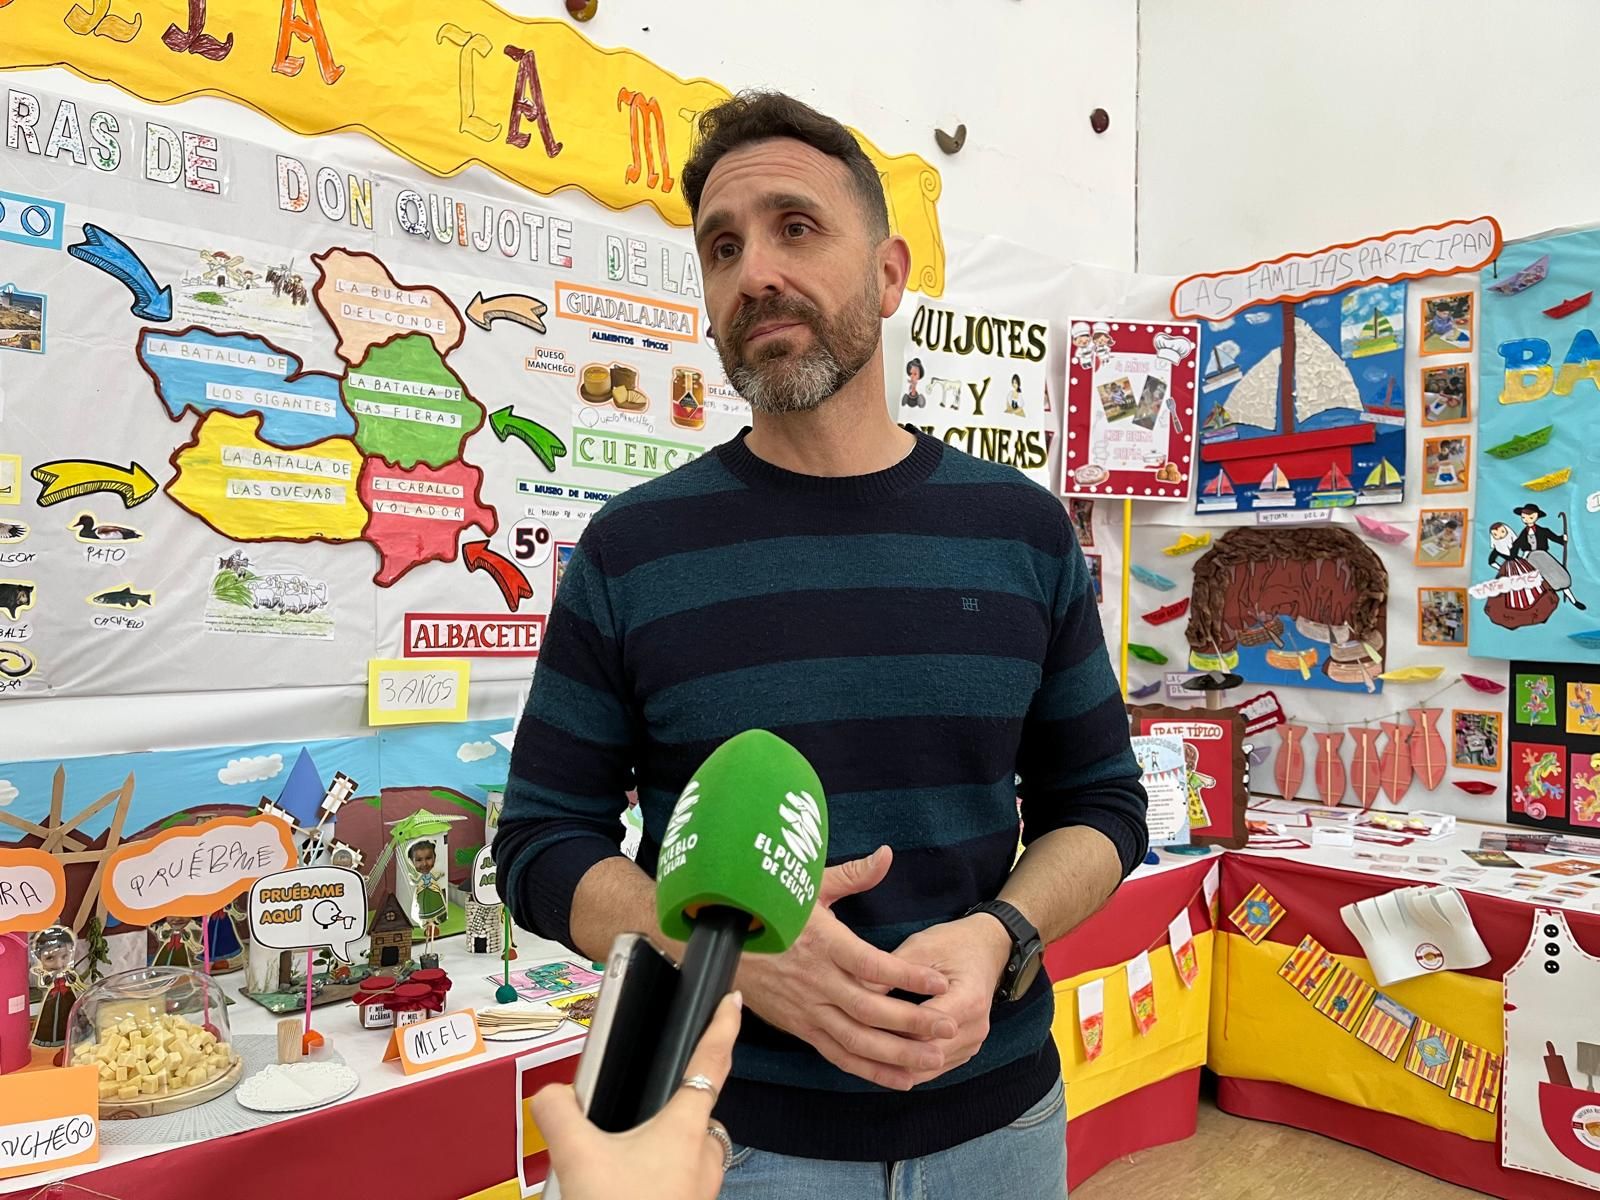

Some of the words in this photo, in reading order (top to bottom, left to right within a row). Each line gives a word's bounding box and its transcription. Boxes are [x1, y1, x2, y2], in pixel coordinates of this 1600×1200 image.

[436, 23, 563, 158] LA
[6, 88, 122, 172] RAS
[146, 121, 222, 195] DE
[276, 154, 374, 230] DON
[396, 189, 573, 268] QUIJOTE
[606, 235, 649, 287] DE
[660, 247, 701, 298] LA
[1178, 278, 1234, 316] LAS
[1246, 253, 1352, 298] FAMILIAS
[1358, 229, 1492, 274] PARTICIPAN
[338, 281, 360, 294] LA
[371, 286, 429, 306] BURLA
[343, 304, 376, 321] DEL
[385, 312, 444, 331] CONDE
[566, 291, 692, 334] GUADALAJARA
[592, 330, 635, 346] ALIMENTOS
[911, 304, 1047, 362] QUIJOTES
[148, 341, 169, 356] LA
[181, 343, 258, 366] BATALLA
[266, 355, 287, 371] DE
[527, 360, 575, 375] MANCHEGO
[536, 349, 565, 361] QUESO
[212, 384, 244, 401] LOS
[253, 390, 331, 412] GIGANTES
[349, 374, 366, 388] LA
[374, 377, 436, 397] BATALLA
[444, 388, 460, 400] DE
[967, 376, 992, 416] Y
[356, 402, 381, 415] LAS
[393, 407, 457, 425] FIERAS
[223, 451, 242, 463] LA
[252, 453, 323, 472] BATALLA
[332, 463, 350, 475] DE
[231, 483, 262, 496] LAS
[270, 486, 332, 500] OVEJAS
[374, 479, 393, 490] EL
[398, 481, 460, 496] CABALLO
[535, 485, 564, 497] MUSEO
[569, 489, 579, 498] DE
[375, 502, 462, 519] VOLADOR
[87, 546, 126, 562] PATO
[515, 527, 550, 560] 5º
[412, 623, 538, 649] ALBACETE
[381, 678, 396, 702] 3
[397, 674, 454, 705] AÑOS
[1186, 723, 1221, 738] TÍPICO
[754, 832, 772, 856] EL
[774, 844, 815, 901] PUEBLO
[260, 883, 344, 903] PRUÉBAME
[761, 855, 777, 876] DE
[779, 871, 806, 907] CEUTA
[260, 904, 303, 925] AQUÍ
[414, 1020, 467, 1059] MIEL
